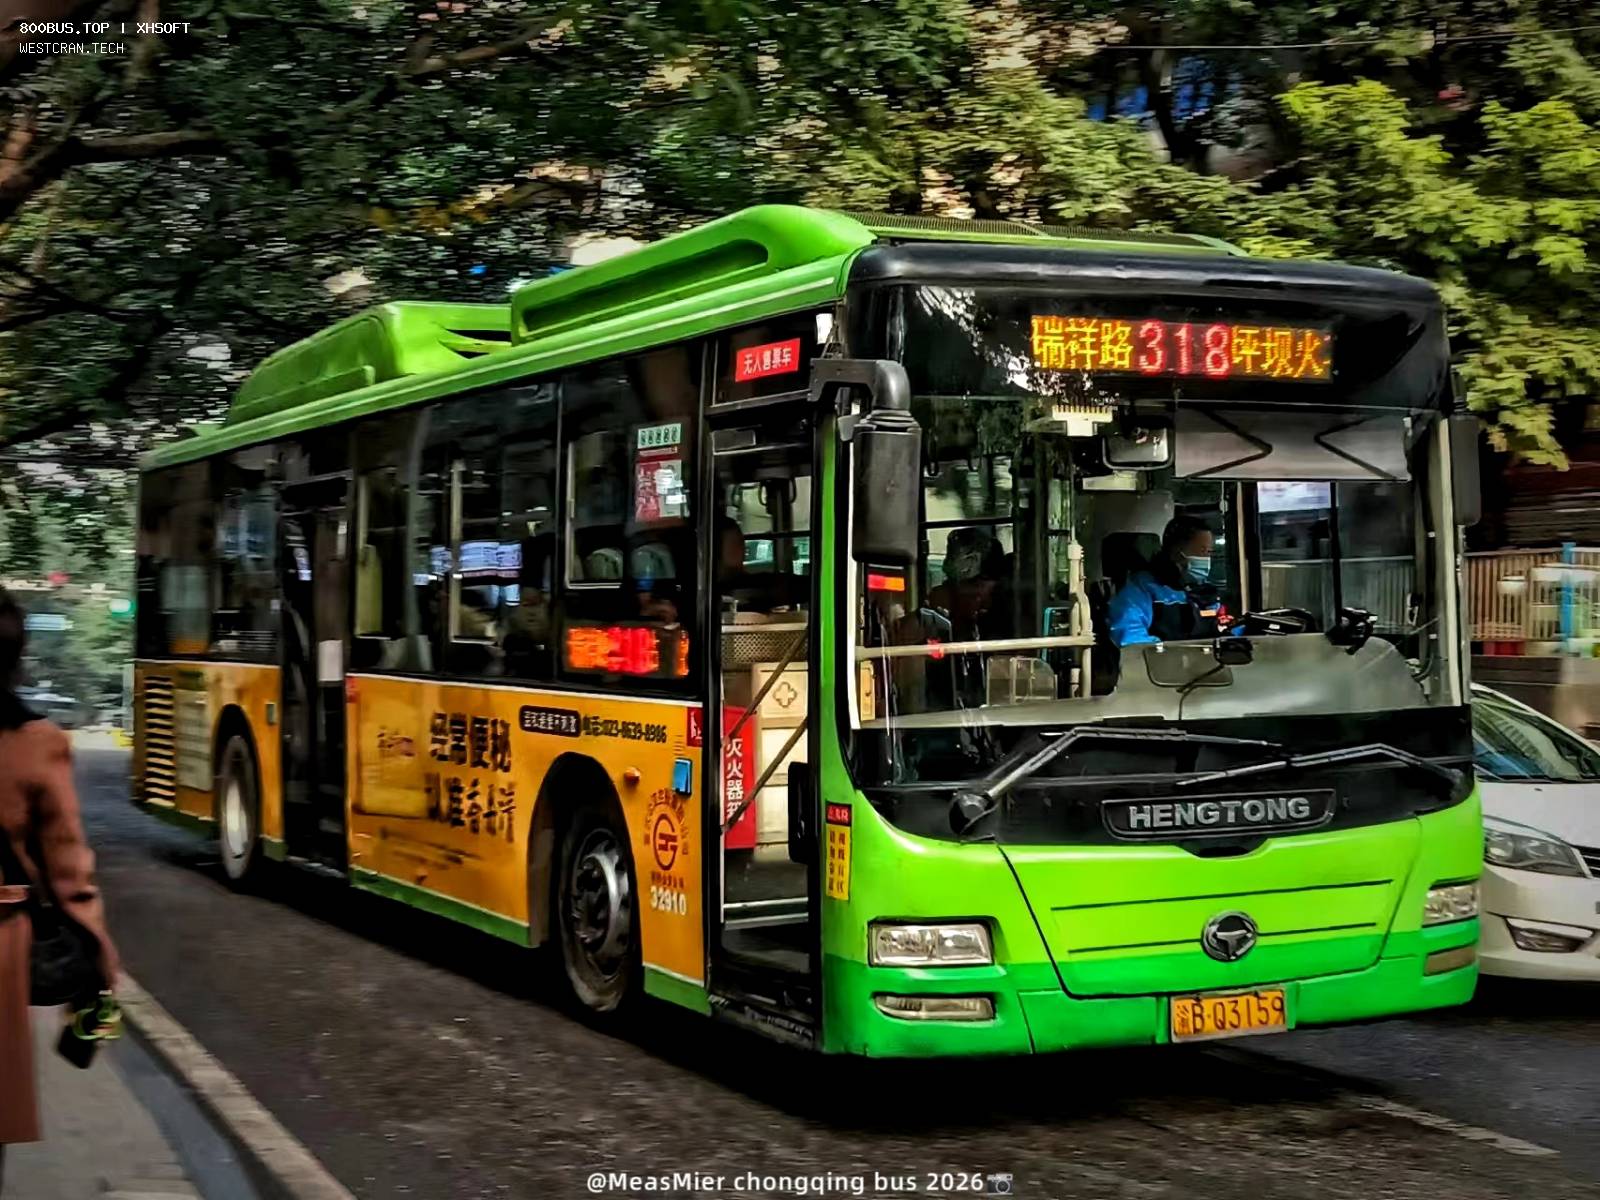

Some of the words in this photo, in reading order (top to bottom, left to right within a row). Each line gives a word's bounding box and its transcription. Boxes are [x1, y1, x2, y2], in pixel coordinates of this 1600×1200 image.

[743, 347, 792, 375] 无人售票车
[1137, 318, 1231, 376] 318
[1129, 797, 1310, 829] HENGTONG
[650, 885, 687, 916] 32910
